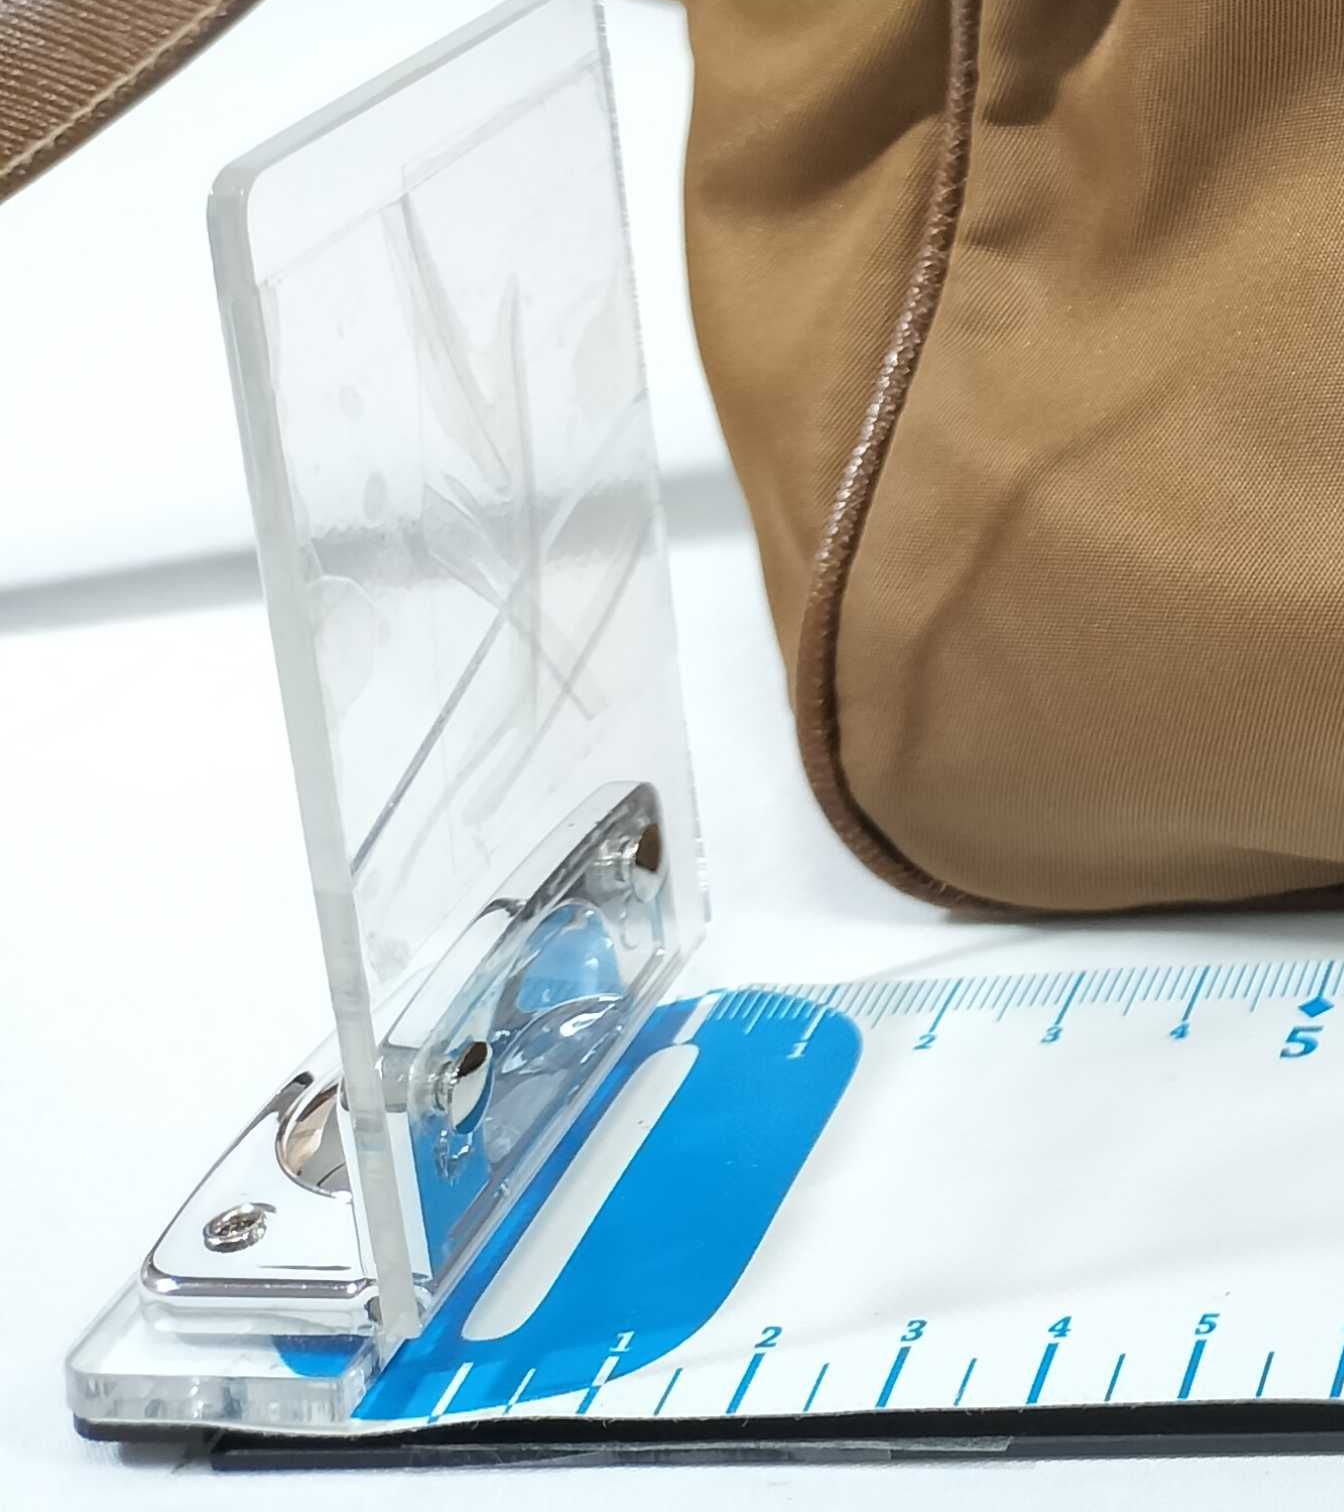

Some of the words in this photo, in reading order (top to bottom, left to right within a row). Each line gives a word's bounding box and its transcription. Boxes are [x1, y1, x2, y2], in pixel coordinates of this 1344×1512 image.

[786, 1042, 809, 1059] 1
[914, 1034, 936, 1050] 2
[1041, 1026, 1063, 1043] 3
[1168, 1025, 1190, 1040] 4
[1280, 1026, 1322, 1059] 5
[610, 1331, 635, 1352] 1
[755, 1327, 782, 1347] 2
[900, 1320, 927, 1341] 3
[1048, 1317, 1072, 1338] 4
[1194, 1313, 1220, 1334] 5
